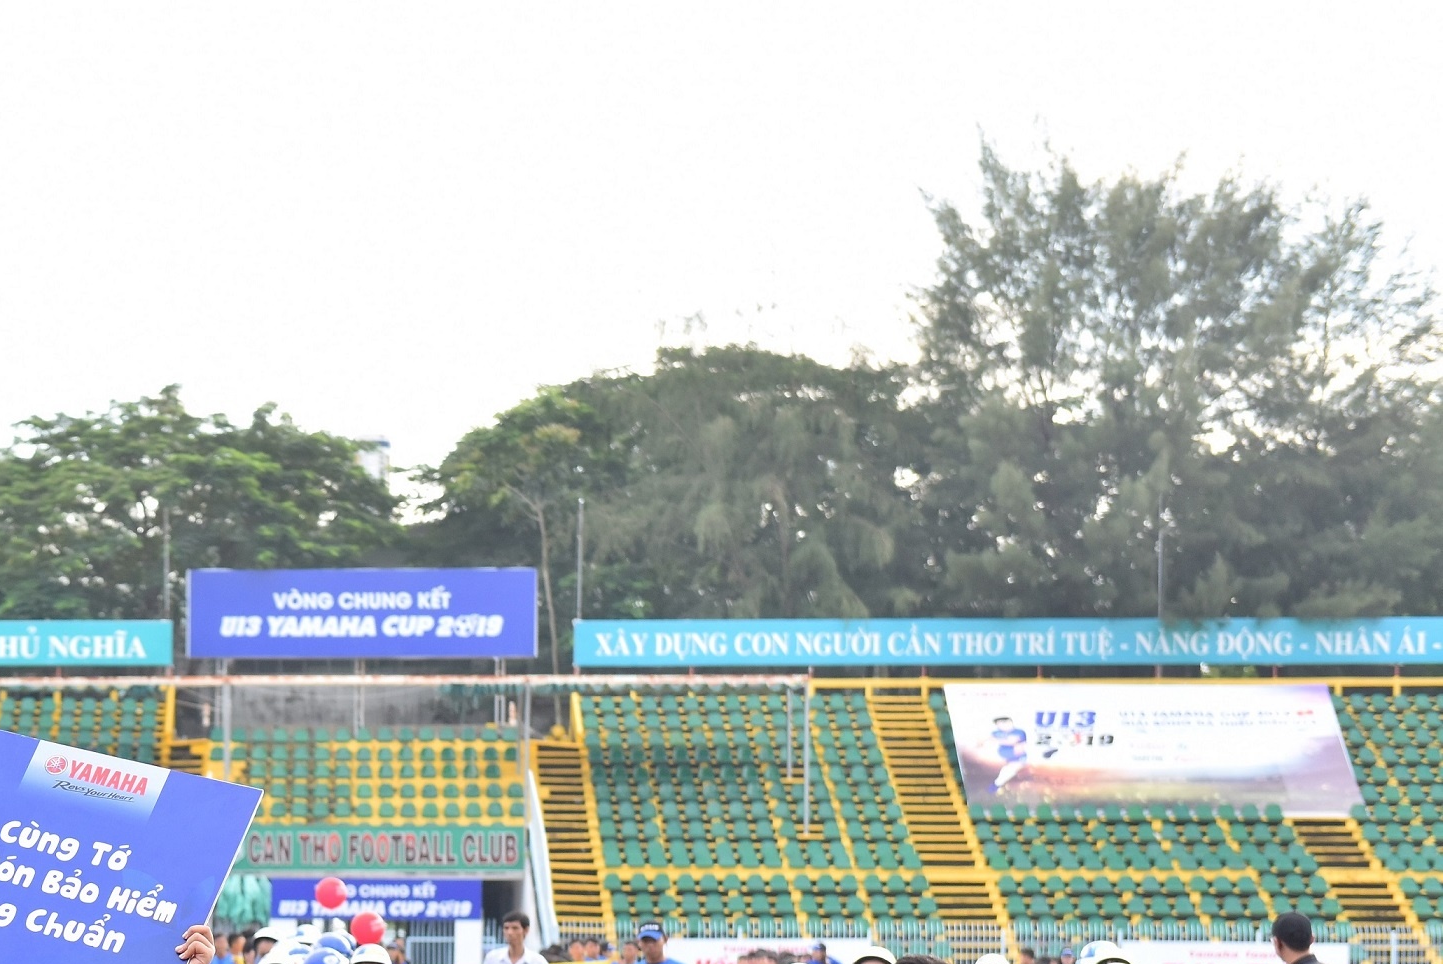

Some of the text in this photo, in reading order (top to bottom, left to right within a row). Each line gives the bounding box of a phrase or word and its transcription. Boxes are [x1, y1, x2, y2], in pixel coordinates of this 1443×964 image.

[273, 585, 451, 610] VÒNG CHUNG KẾT
[219, 616, 262, 637] U13
[267, 615, 377, 637] YAMAHA
[381, 615, 434, 637] CUP
[47, 630, 147, 660] NGHĨA
[595, 627, 649, 657] XÂY
[655, 631, 728, 661] DỰNG
[733, 631, 788, 656] CON
[796, 625, 882, 656] NGƯỜI
[887, 623, 944, 656] CẦN
[947, 630, 1004, 656] THƠ
[1010, 625, 1057, 656] TRÍ
[1061, 625, 1114, 659] TUỆ
[1217, 627, 1293, 660] ĐỘNG
[1314, 627, 1392, 656] NHÂN
[1397, 625, 1426, 656] ÁI
[1035, 711, 1097, 728] U13
[52, 779, 87, 792] Revs
[69, 759, 149, 796] YAMAHA
[0, 820, 132, 871] Cùng Tớ
[348, 832, 456, 863] FOOTBALL
[461, 831, 518, 863] CLUB
[41, 868, 100, 904] Bảo
[106, 884, 178, 924] Hiểm
[359, 884, 411, 899] CHUNG
[412, 880, 437, 899] KẾT
[278, 900, 309, 917] U13
[388, 900, 425, 917] CUP
[25, 908, 126, 954] Chuẩn
